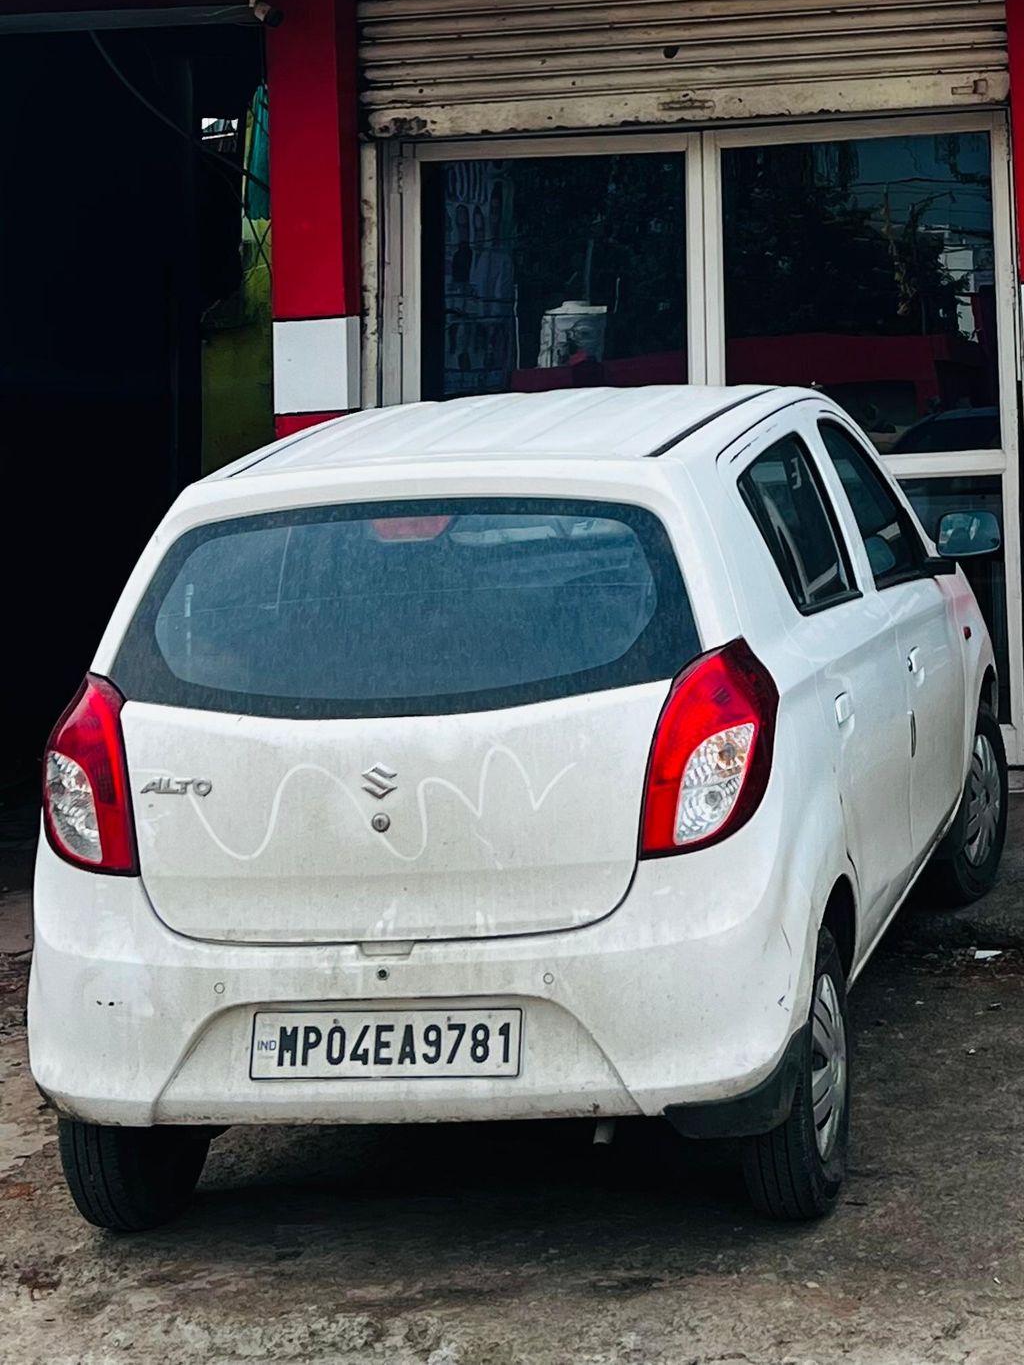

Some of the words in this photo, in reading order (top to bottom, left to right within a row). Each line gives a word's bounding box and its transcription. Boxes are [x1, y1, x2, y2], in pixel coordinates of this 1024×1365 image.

[140, 778, 213, 797] ALTO
[257, 1039, 277, 1052] IND
[277, 1022, 511, 1067] MP04EA9781
